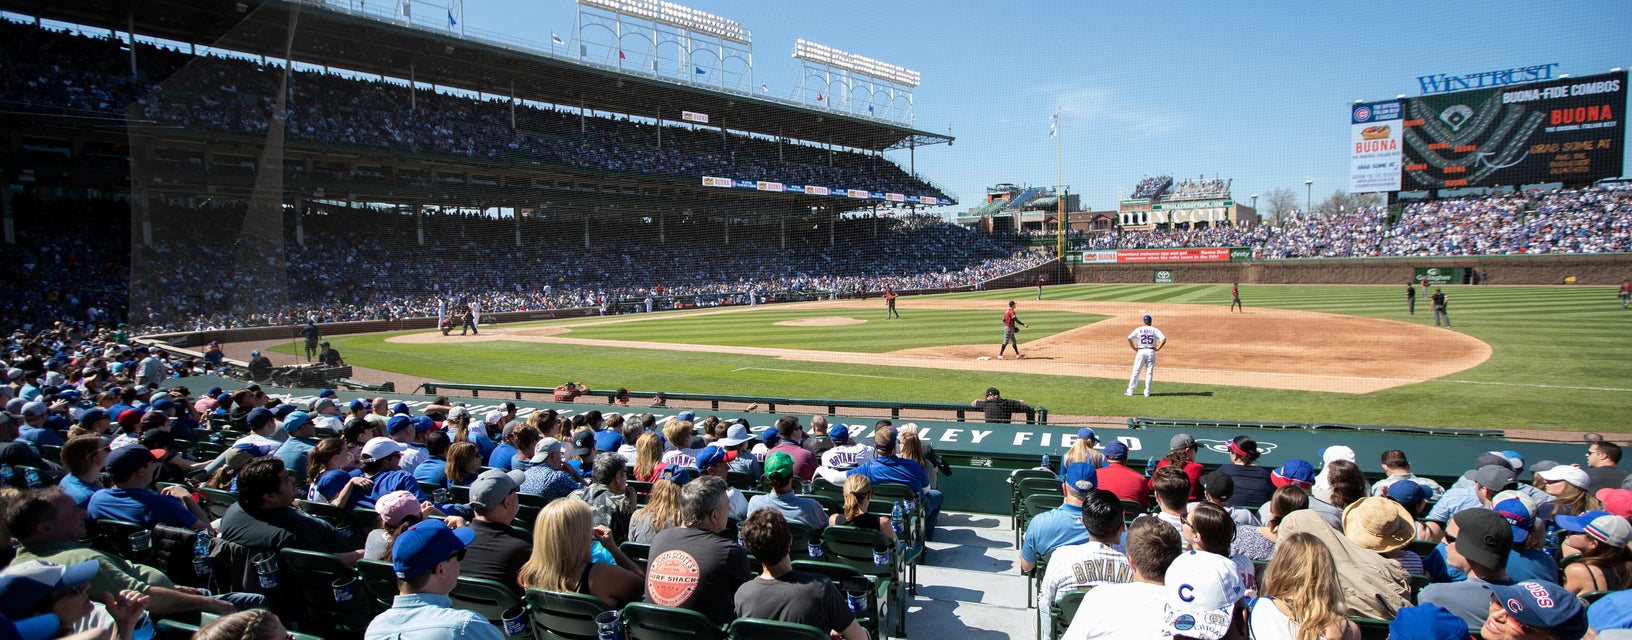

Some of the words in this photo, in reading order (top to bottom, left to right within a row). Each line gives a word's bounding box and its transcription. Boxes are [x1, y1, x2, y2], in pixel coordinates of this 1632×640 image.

[1417, 62, 1559, 93] WINTRUST
[1502, 85, 1569, 104] BUONA-FIDE
[1570, 79, 1620, 96] COMBOS
[1551, 104, 1612, 125] BUONA
[1355, 139, 1397, 154] BUONA
[1562, 140, 1594, 152] SOME
[1597, 139, 1612, 149] AT
[1140, 334, 1154, 344] 25
[806, 423, 992, 444] RILEY
[1012, 431, 1143, 451] FIED
[829, 452, 857, 467] BRYANT
[1072, 558, 1134, 584] BRYAN
[667, 576, 697, 584] SHACK
[1178, 583, 1195, 602] C
[1508, 598, 1523, 614] C
